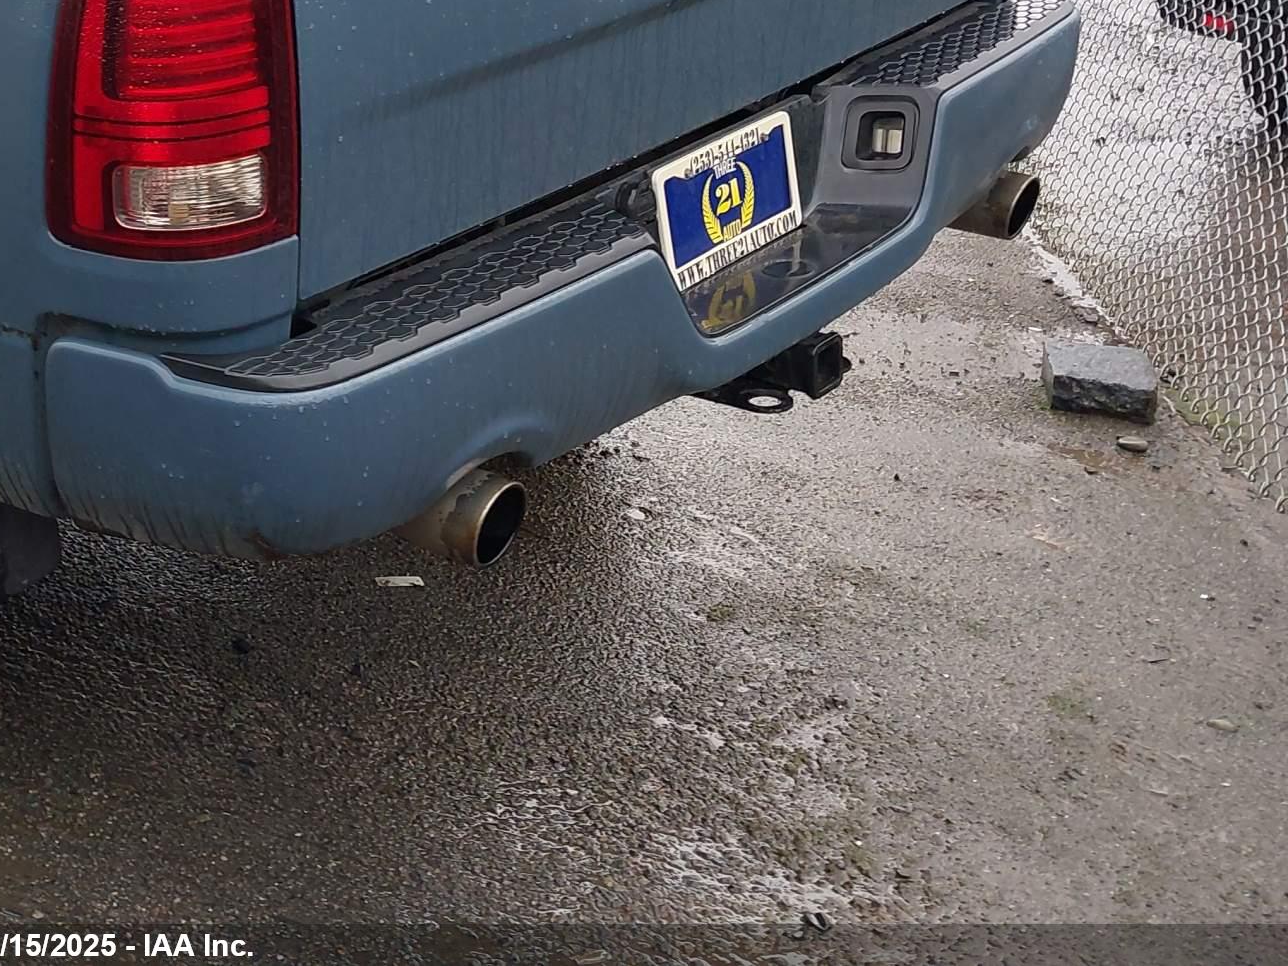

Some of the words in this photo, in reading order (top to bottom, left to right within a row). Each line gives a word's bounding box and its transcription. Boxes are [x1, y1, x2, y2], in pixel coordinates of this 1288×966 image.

[713, 157, 737, 179] THREE
[715, 177, 743, 215] 21
[722, 219, 742, 242] AUTO
[677, 210, 798, 291] WWW.THREE21AUTO.COM
